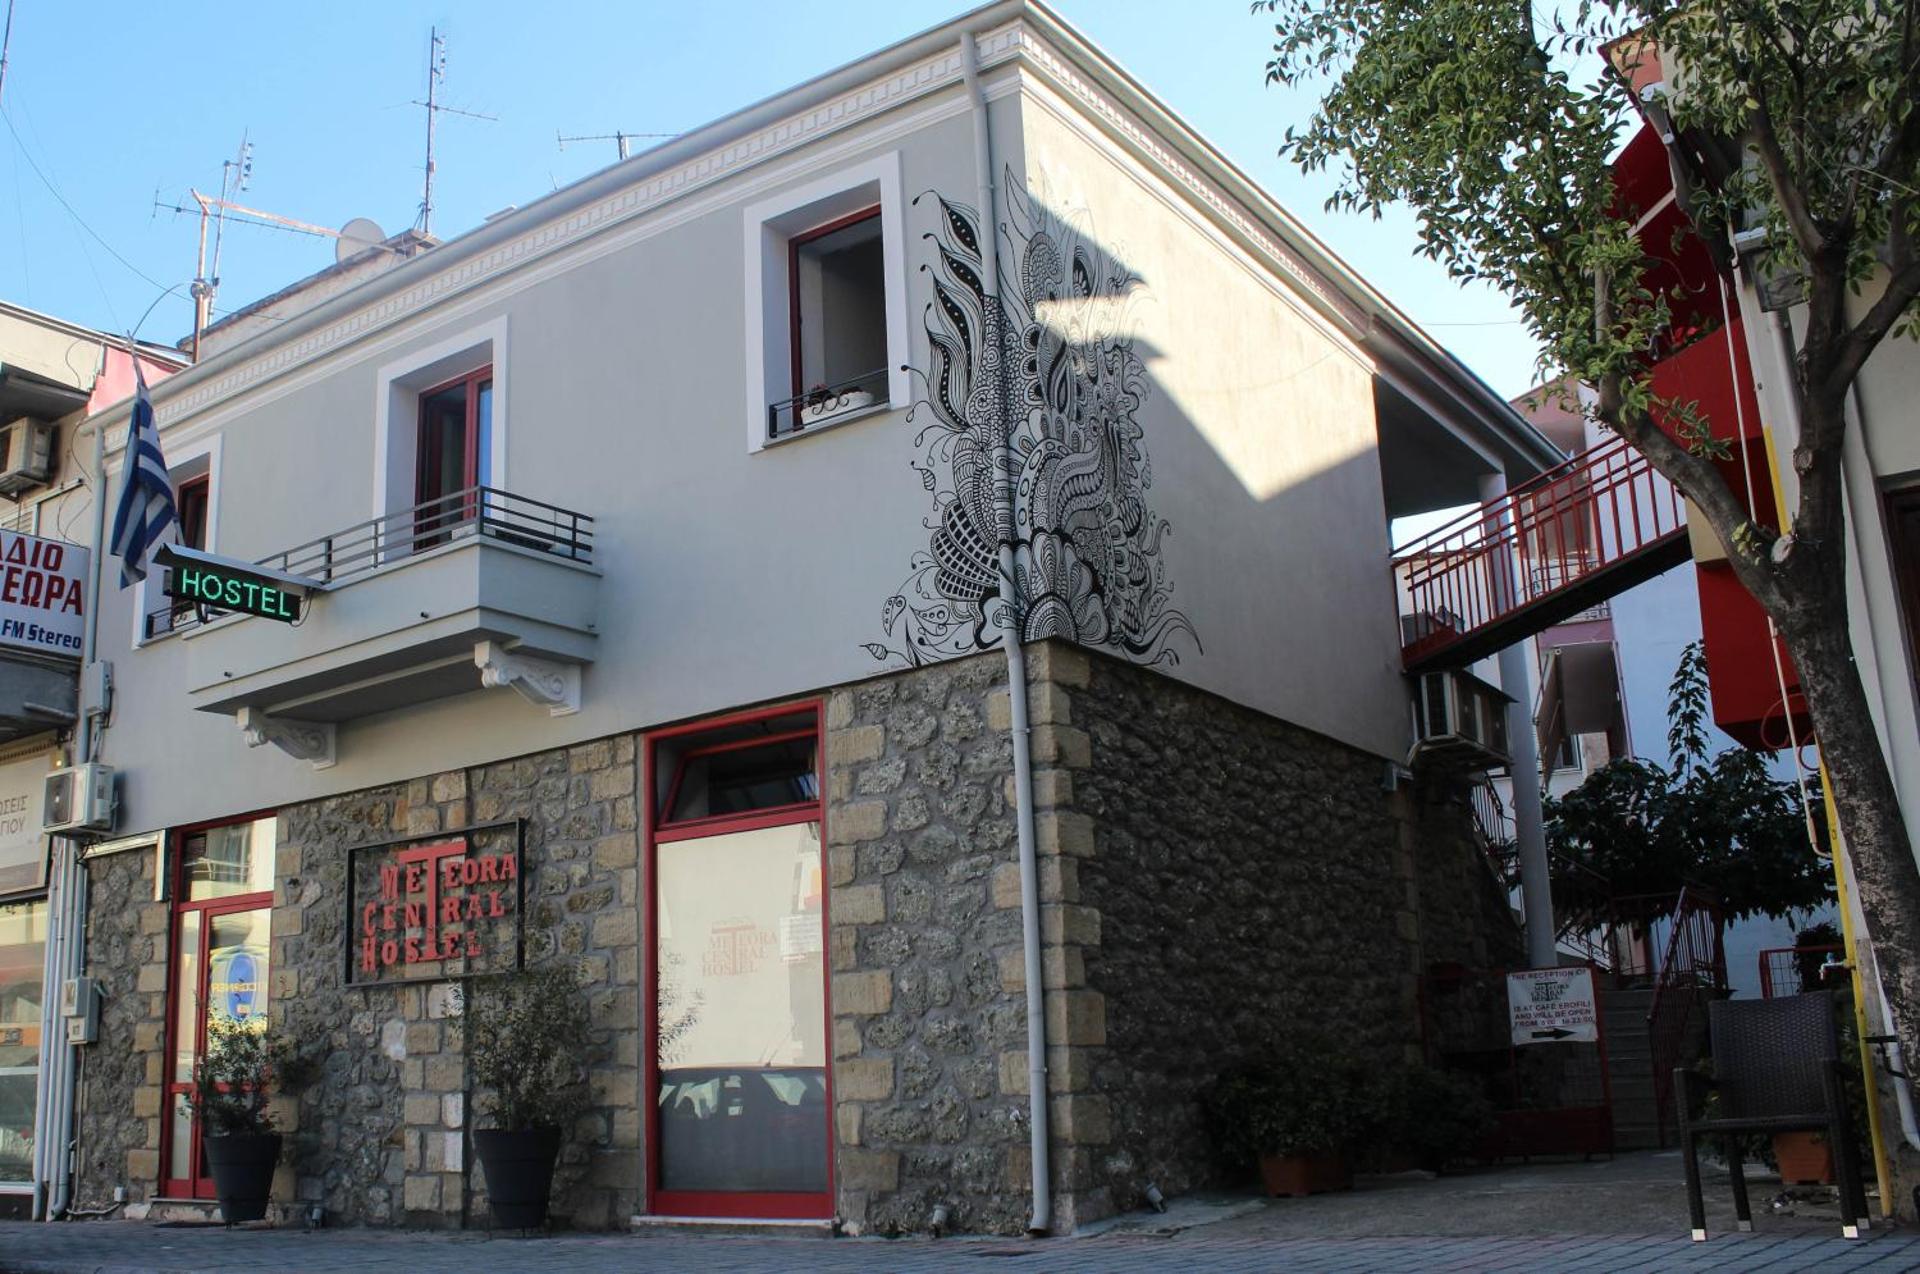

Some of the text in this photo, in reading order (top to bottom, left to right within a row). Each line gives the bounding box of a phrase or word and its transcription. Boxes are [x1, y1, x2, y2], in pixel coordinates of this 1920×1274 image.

[0, 533, 63, 571] ΔΙΟ
[182, 568, 291, 616] HOSTEL
[2, 619, 82, 649] FM Stereo
[380, 841, 518, 900] METEORA
[363, 889, 506, 937] CENTRAL
[361, 929, 482, 973] HOSTEL
[1528, 969, 1574, 979] RECEPTION
[1515, 1008, 1592, 1020] AND WILL BE OPEN
